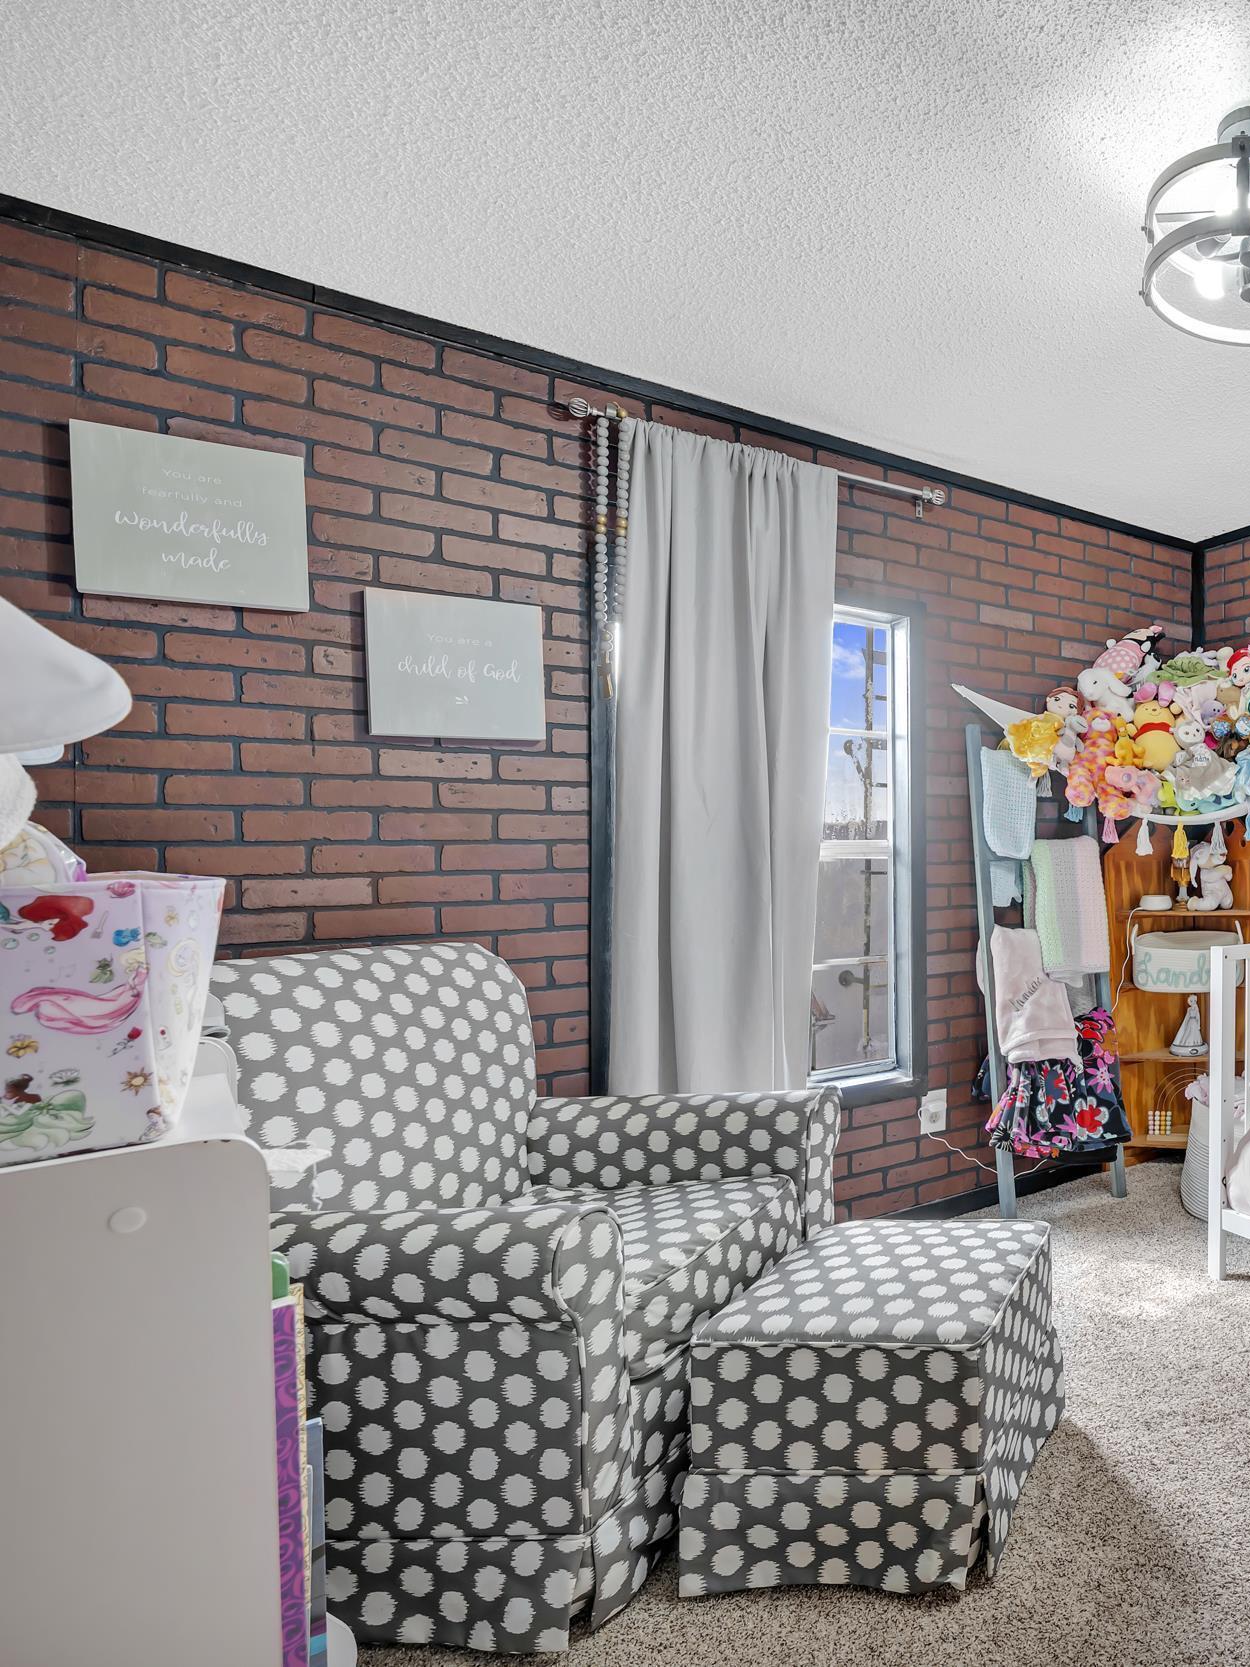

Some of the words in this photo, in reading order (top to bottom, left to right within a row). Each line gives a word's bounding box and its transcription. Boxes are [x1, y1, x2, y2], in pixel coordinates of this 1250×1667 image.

[161, 468, 192, 480] You
[198, 475, 222, 485] are
[141, 486, 208, 504] fearfully
[214, 497, 243, 508] and
[162, 549, 231, 573] made
[427, 633, 454, 643] You
[398, 654, 452, 678] child
[457, 659, 478, 683] of
[483, 658, 521, 683] God
